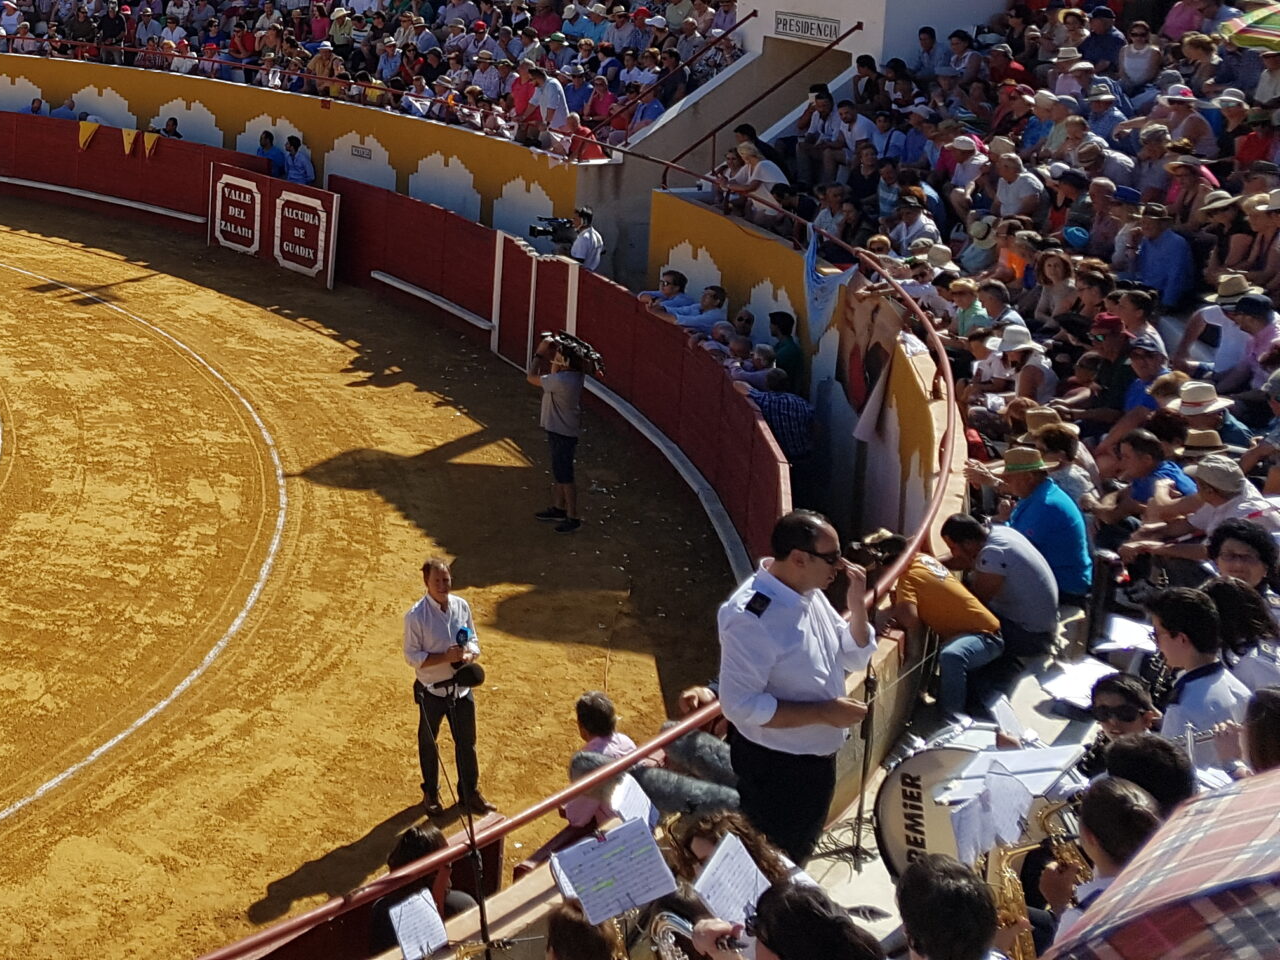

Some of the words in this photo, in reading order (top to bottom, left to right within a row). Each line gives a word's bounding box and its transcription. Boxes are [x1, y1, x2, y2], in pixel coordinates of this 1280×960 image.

[776, 17, 838, 39] PRESIDENCIA
[224, 187, 252, 204] VALLE
[228, 205, 246, 220] DEL
[283, 207, 319, 226] ALCUDIA
[294, 227, 306, 239] DE
[283, 241, 315, 259] GUADIX
